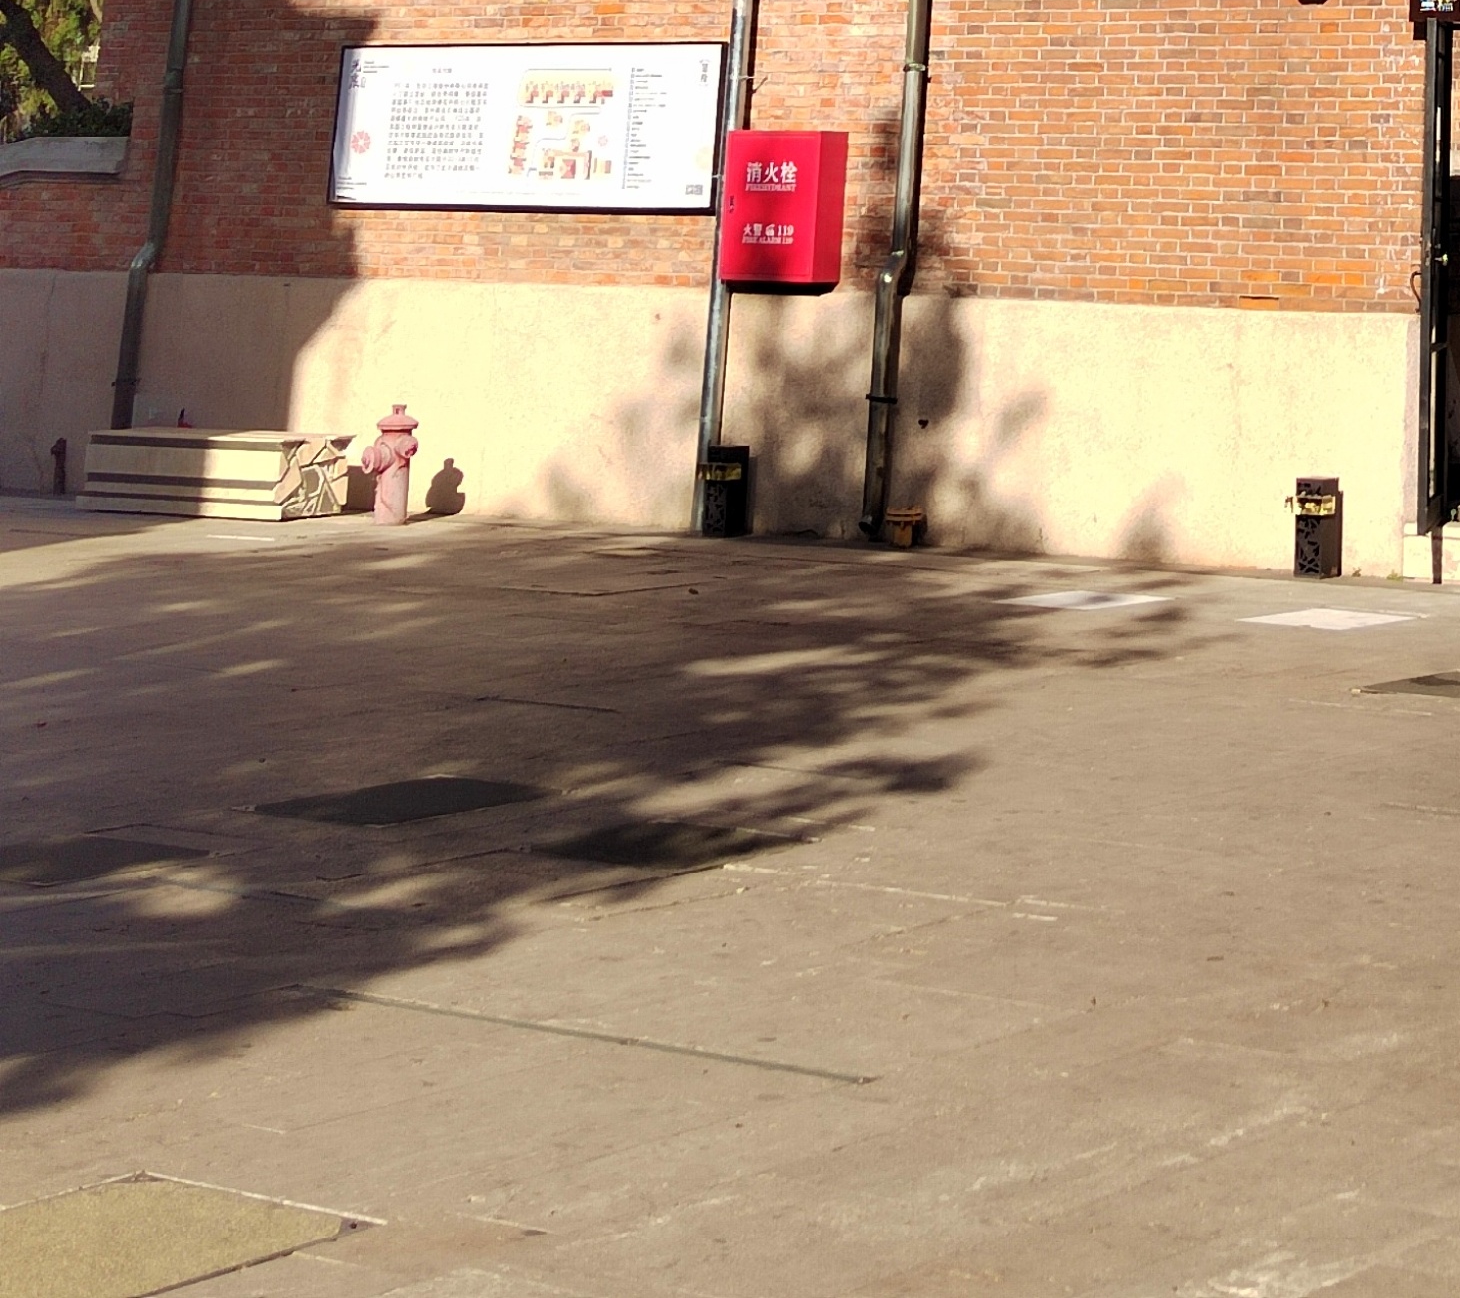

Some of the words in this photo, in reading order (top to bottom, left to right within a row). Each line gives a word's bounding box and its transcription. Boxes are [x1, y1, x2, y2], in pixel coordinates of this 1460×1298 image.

[746, 161, 798, 183] 消火栓
[777, 224, 794, 236] 119
